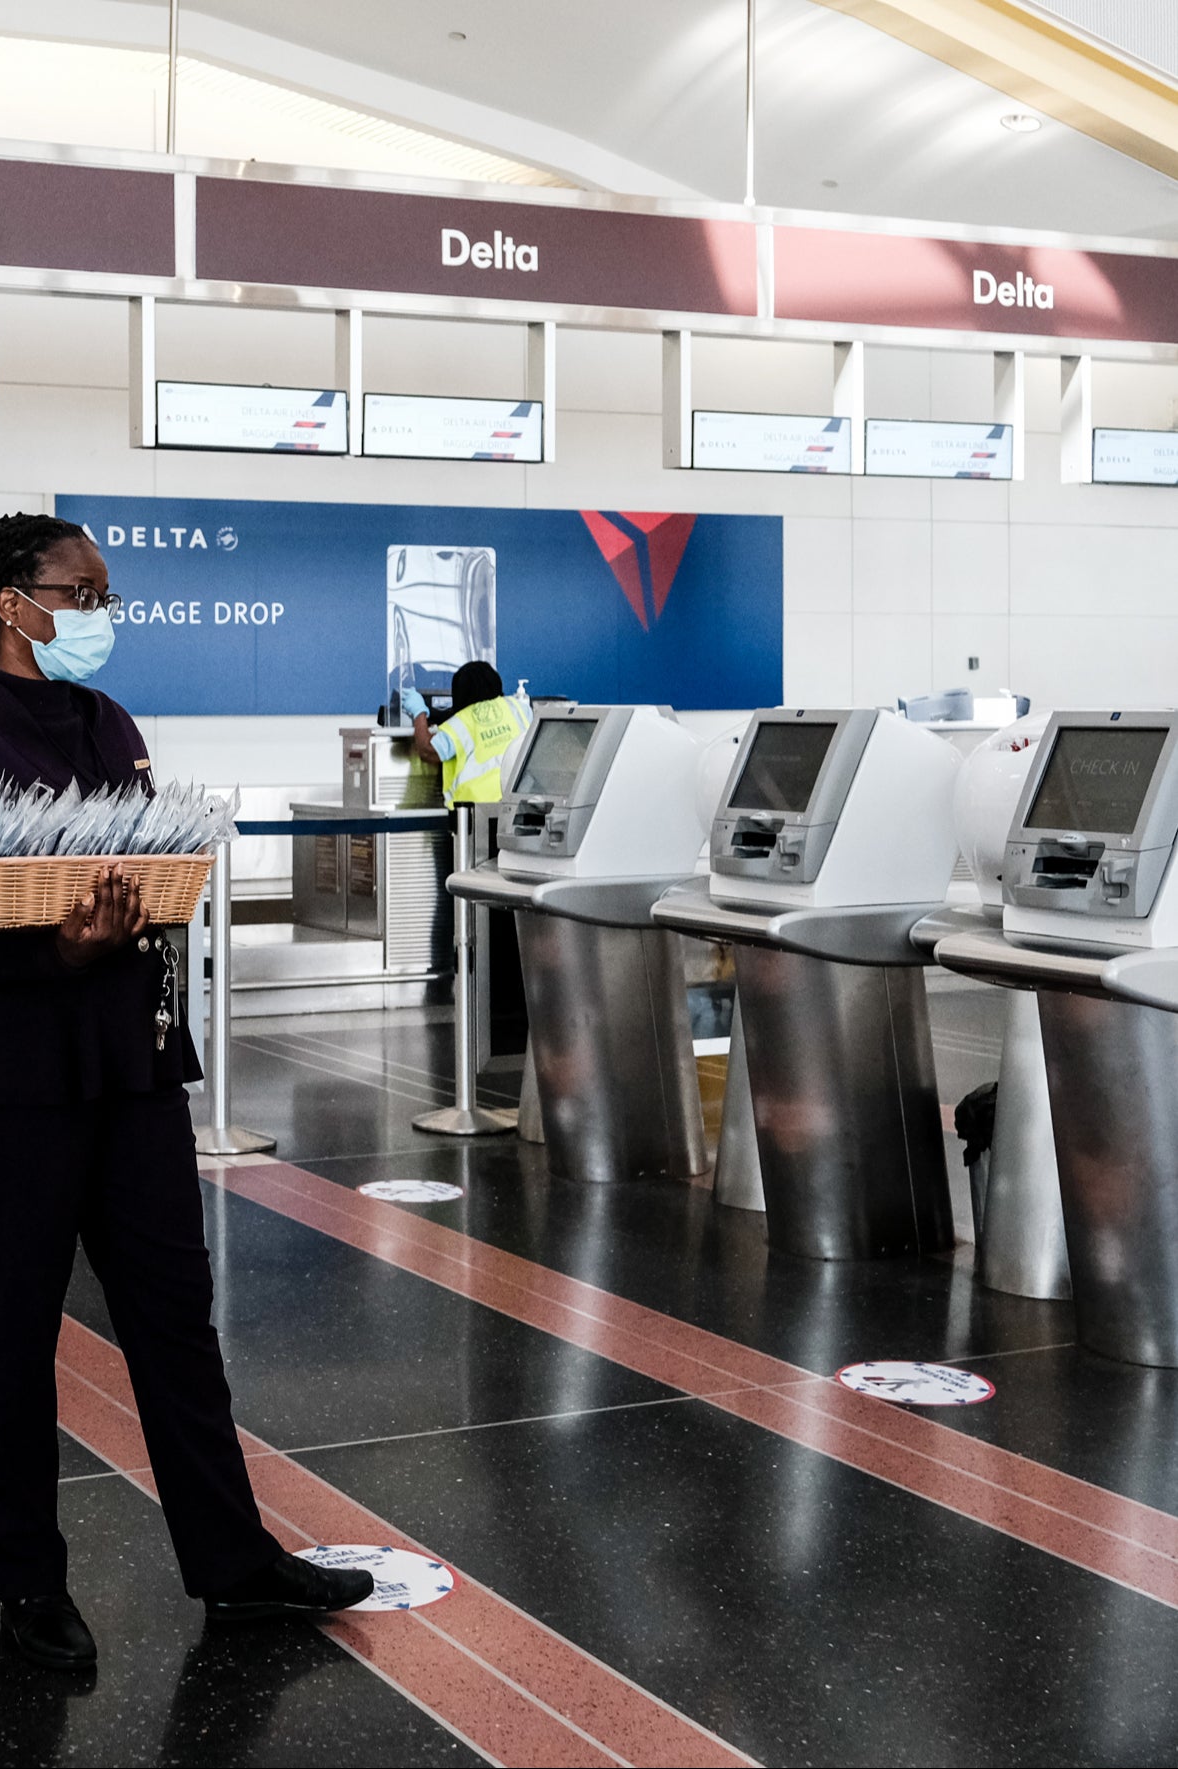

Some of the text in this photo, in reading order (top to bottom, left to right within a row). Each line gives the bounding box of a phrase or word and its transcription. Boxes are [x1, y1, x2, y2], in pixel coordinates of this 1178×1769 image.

[441, 228, 539, 272] Delta
[972, 270, 1054, 310] Delta
[175, 414, 209, 424] DELTA
[381, 426, 413, 434] DELTA
[107, 525, 208, 549] DELTA
[111, 600, 285, 625] GGAGE DROP
[1070, 759, 1141, 776] CHECK IN
[304, 1549, 359, 1560] SOCIAL
